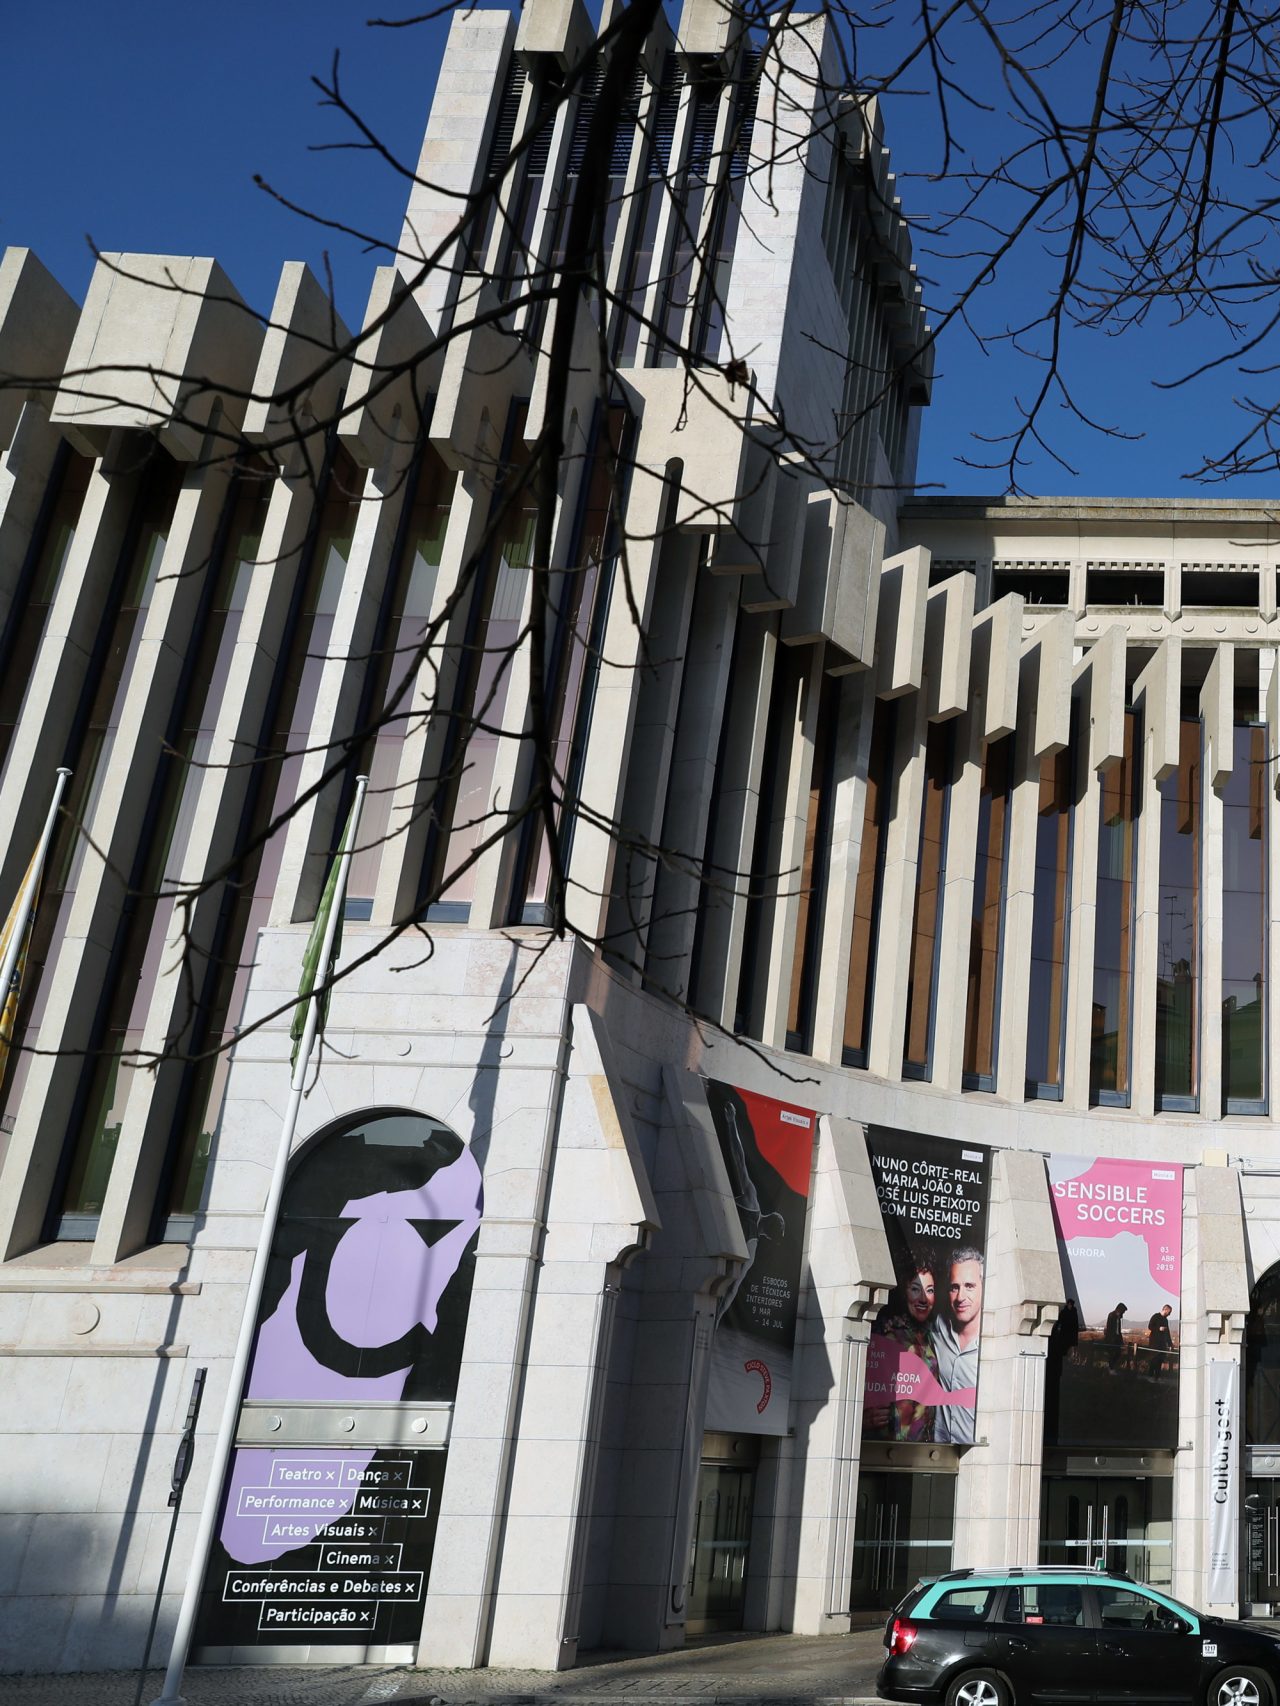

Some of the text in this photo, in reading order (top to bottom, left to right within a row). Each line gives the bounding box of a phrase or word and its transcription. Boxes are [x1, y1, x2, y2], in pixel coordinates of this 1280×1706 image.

[872, 1155, 983, 1185] NUNO CÔRTE-REAL
[882, 1171, 964, 1196] MARIA JOÃO &
[877, 1186, 980, 1213] OSÉ LUIS PEIXOTO
[1055, 1181, 1148, 1204] SENSIBLE
[880, 1202, 973, 1227] COM ENSEMBLE
[1077, 1204, 1165, 1226] SOCCERS
[915, 1222, 962, 1240] DARCOS
[1067, 1247, 1106, 1258] AURORA
[762, 1275, 788, 1288] ESBOÇOS
[751, 1284, 791, 1299] DE TÉCNICAS
[746, 1294, 783, 1308] INTERIORES
[759, 1307, 771, 1316] MAR
[762, 1318, 770, 1327] 14
[772, 1319, 784, 1329] JUL
[891, 1371, 921, 1384] AGORA
[864, 1382, 913, 1395] UDA TUDO
[279, 1468, 322, 1480] Teatro
[347, 1468, 389, 1484] Dança
[245, 1495, 335, 1509] Performance
[360, 1495, 408, 1509] Música
[271, 1523, 310, 1537] Artes
[314, 1523, 365, 1537] Visuais
[326, 1551, 380, 1565] Cinema
[231, 1579, 325, 1593] Conferências
[330, 1584, 339, 1593] e
[343, 1579, 401, 1593] Debates
[266, 1608, 356, 1625] Participação
